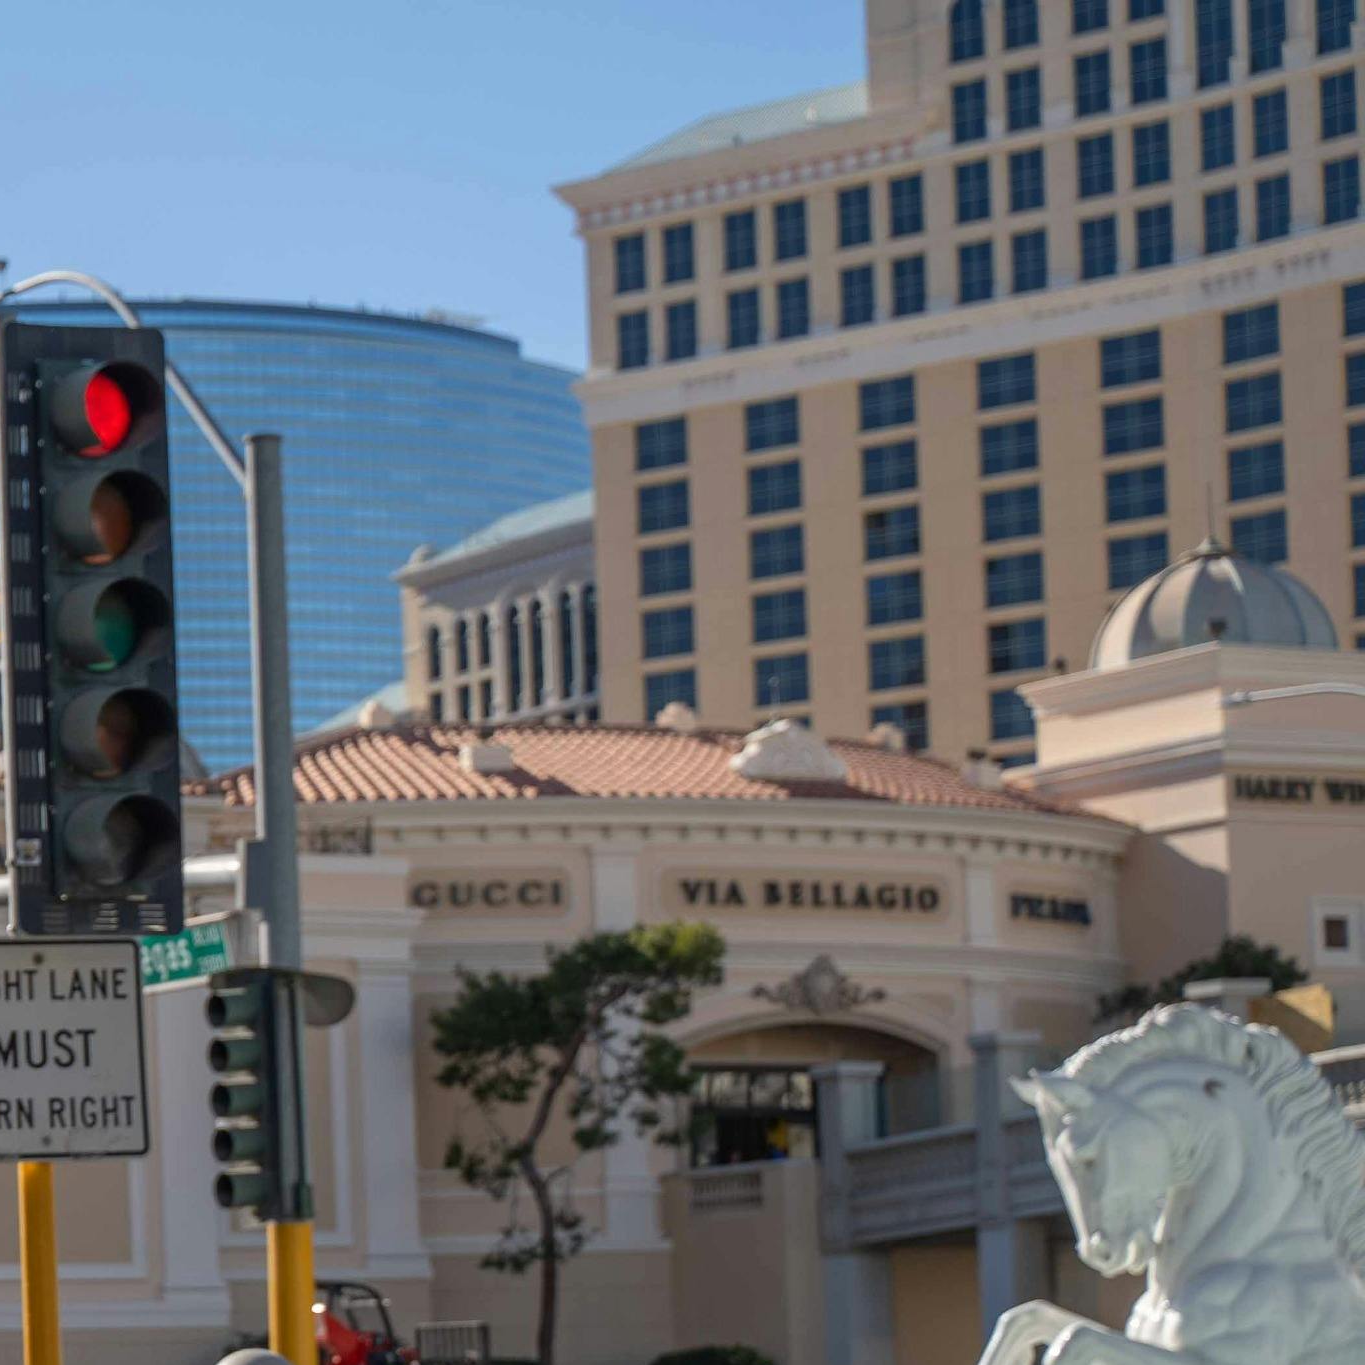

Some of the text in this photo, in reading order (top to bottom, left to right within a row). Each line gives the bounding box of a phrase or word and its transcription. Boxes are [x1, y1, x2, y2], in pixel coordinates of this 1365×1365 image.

[1236, 775, 1314, 801] HARRY
[411, 879, 563, 908] GUCCI
[680, 879, 941, 912] VIA BELLAGIO
[49, 967, 128, 1000] LANE
[48, 1095, 136, 1129] RIGHT
